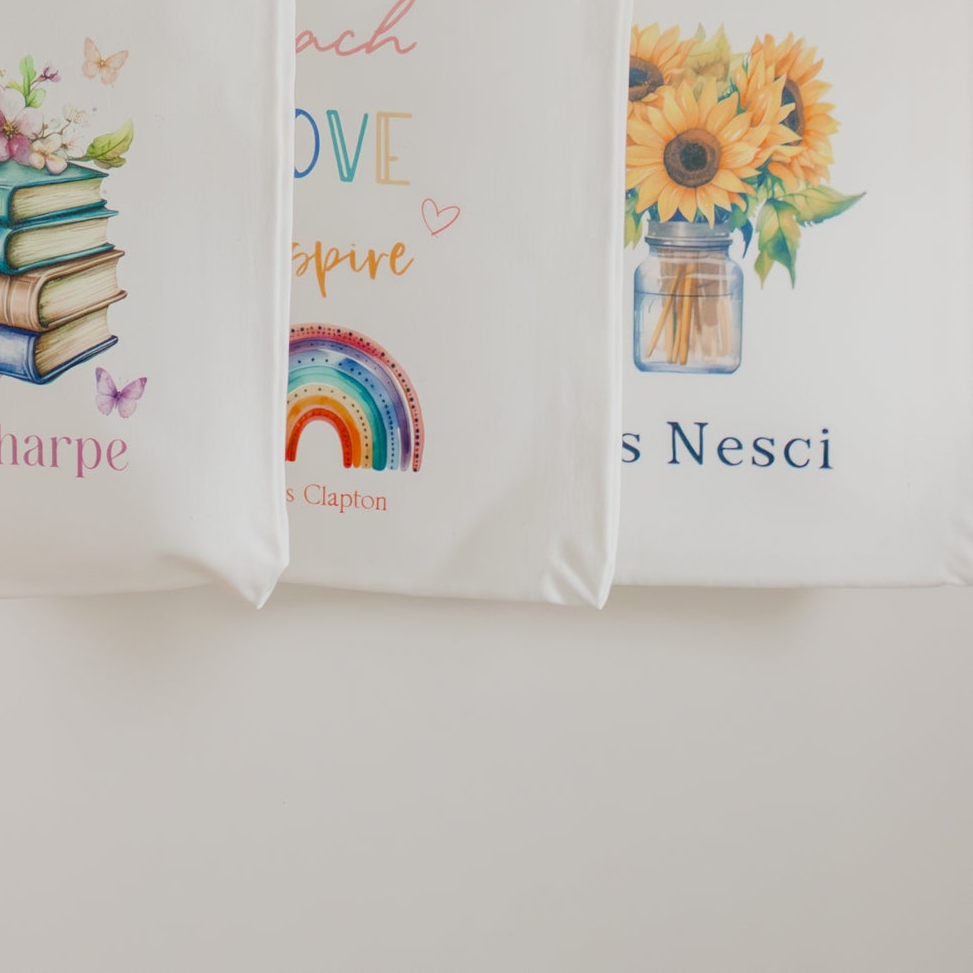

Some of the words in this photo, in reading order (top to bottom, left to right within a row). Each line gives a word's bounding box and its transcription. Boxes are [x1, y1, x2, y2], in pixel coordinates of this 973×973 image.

[293, 108, 413, 186] OVE
[292, 240, 415, 298] spire
[666, 421, 834, 470] Nesci
[303, 484, 387, 514] Clapton
